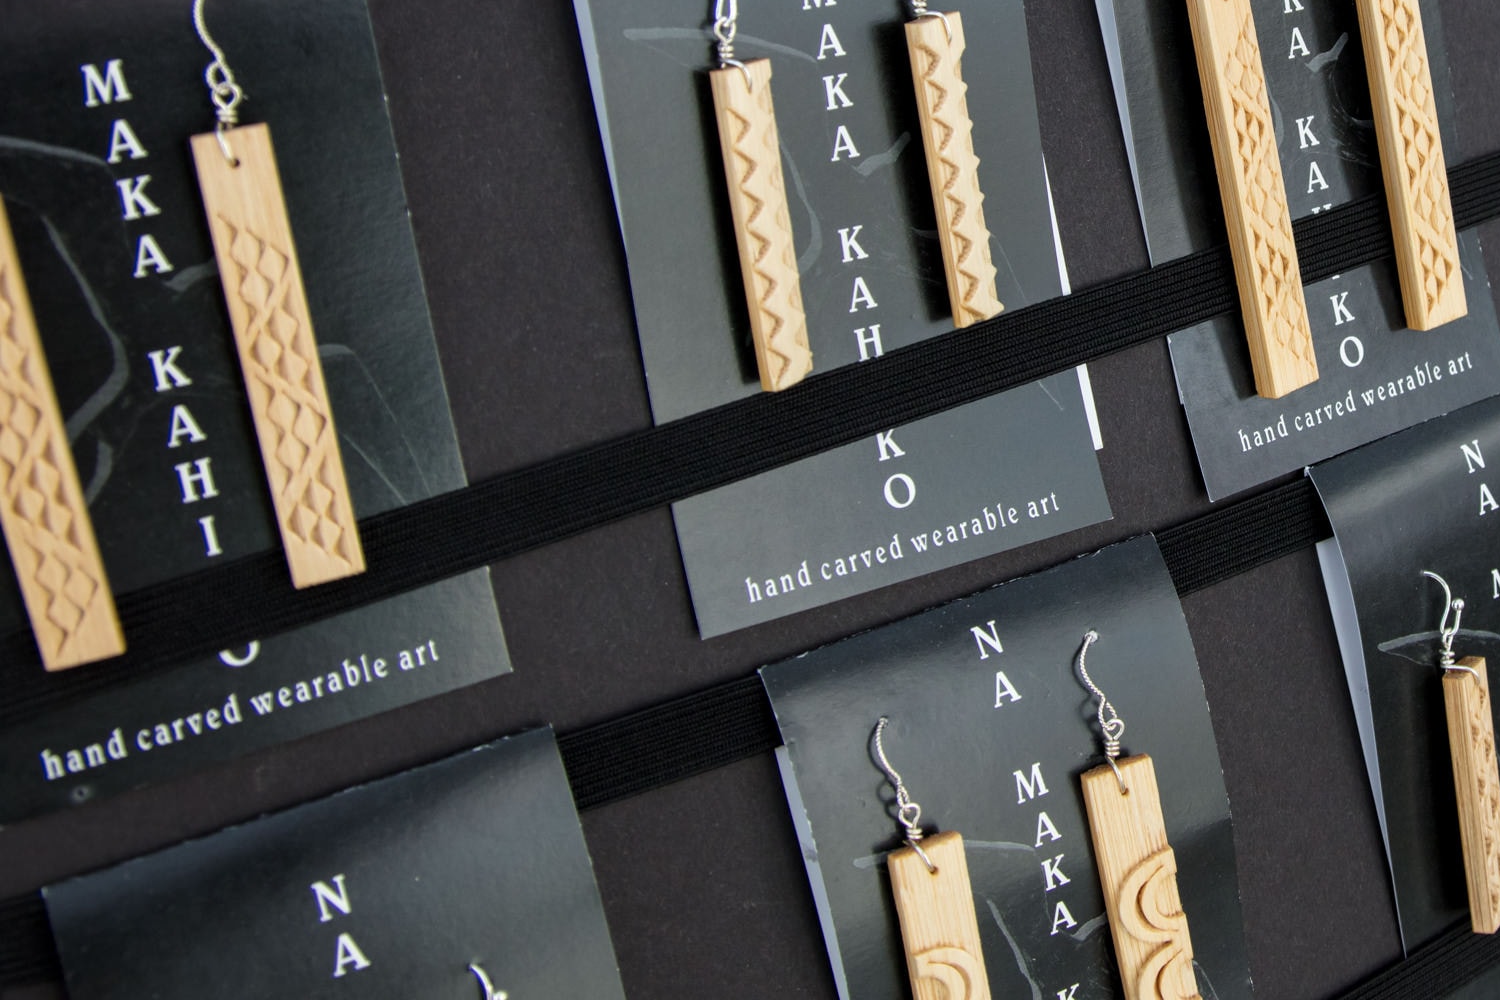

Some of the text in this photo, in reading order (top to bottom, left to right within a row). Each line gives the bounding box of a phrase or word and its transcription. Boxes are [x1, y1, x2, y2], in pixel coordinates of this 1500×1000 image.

[81, 58, 174, 277] MAKA
[1238, 350, 1473, 454] hand carved wearable art
[1460, 439, 1500, 517] NA
[744, 490, 1061, 604] hand carved wearable art
[40, 638, 440, 781] hand carved wearable art
[970, 620, 1022, 709] NA
[1012, 762, 1078, 936] MAKA
[310, 874, 371, 978] NA
